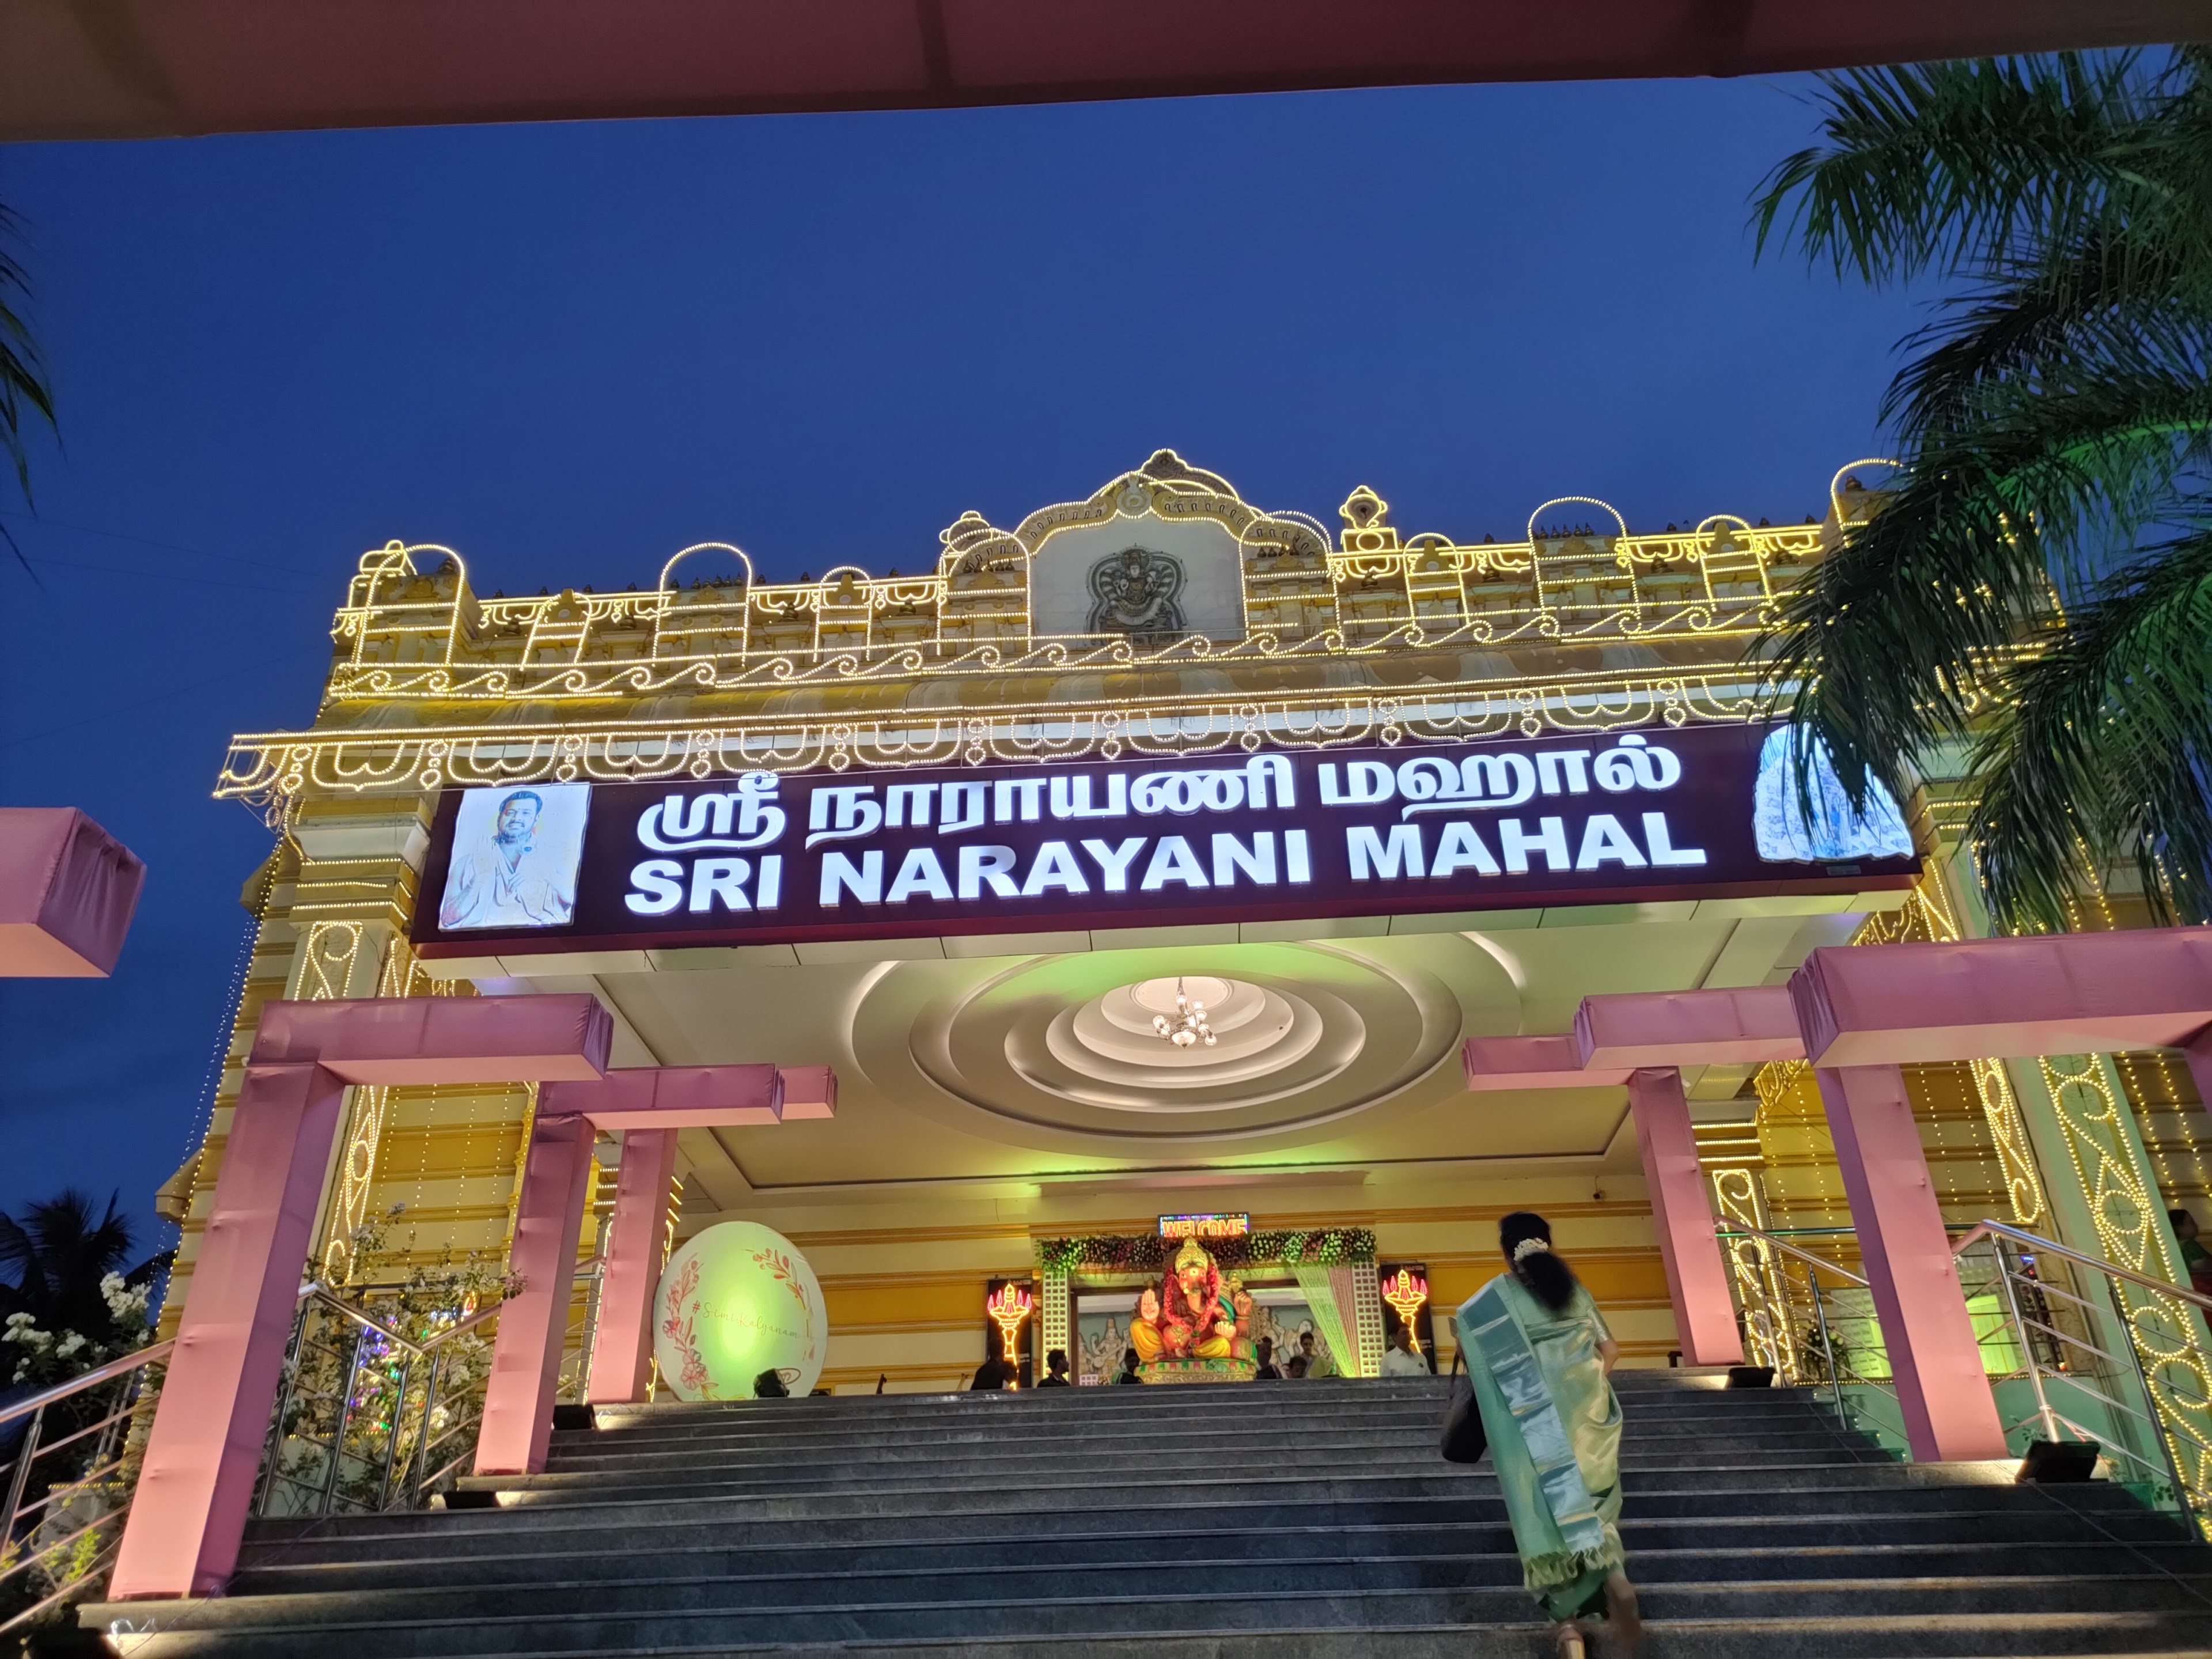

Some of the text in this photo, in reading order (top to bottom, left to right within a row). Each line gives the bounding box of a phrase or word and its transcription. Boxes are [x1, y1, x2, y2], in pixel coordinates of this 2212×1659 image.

[805, 754, 1296, 850] நாராயணி
[1317, 734, 1681, 822] மஹால்
[624, 812, 1708, 916] SRI NARAYANI MAHAL
